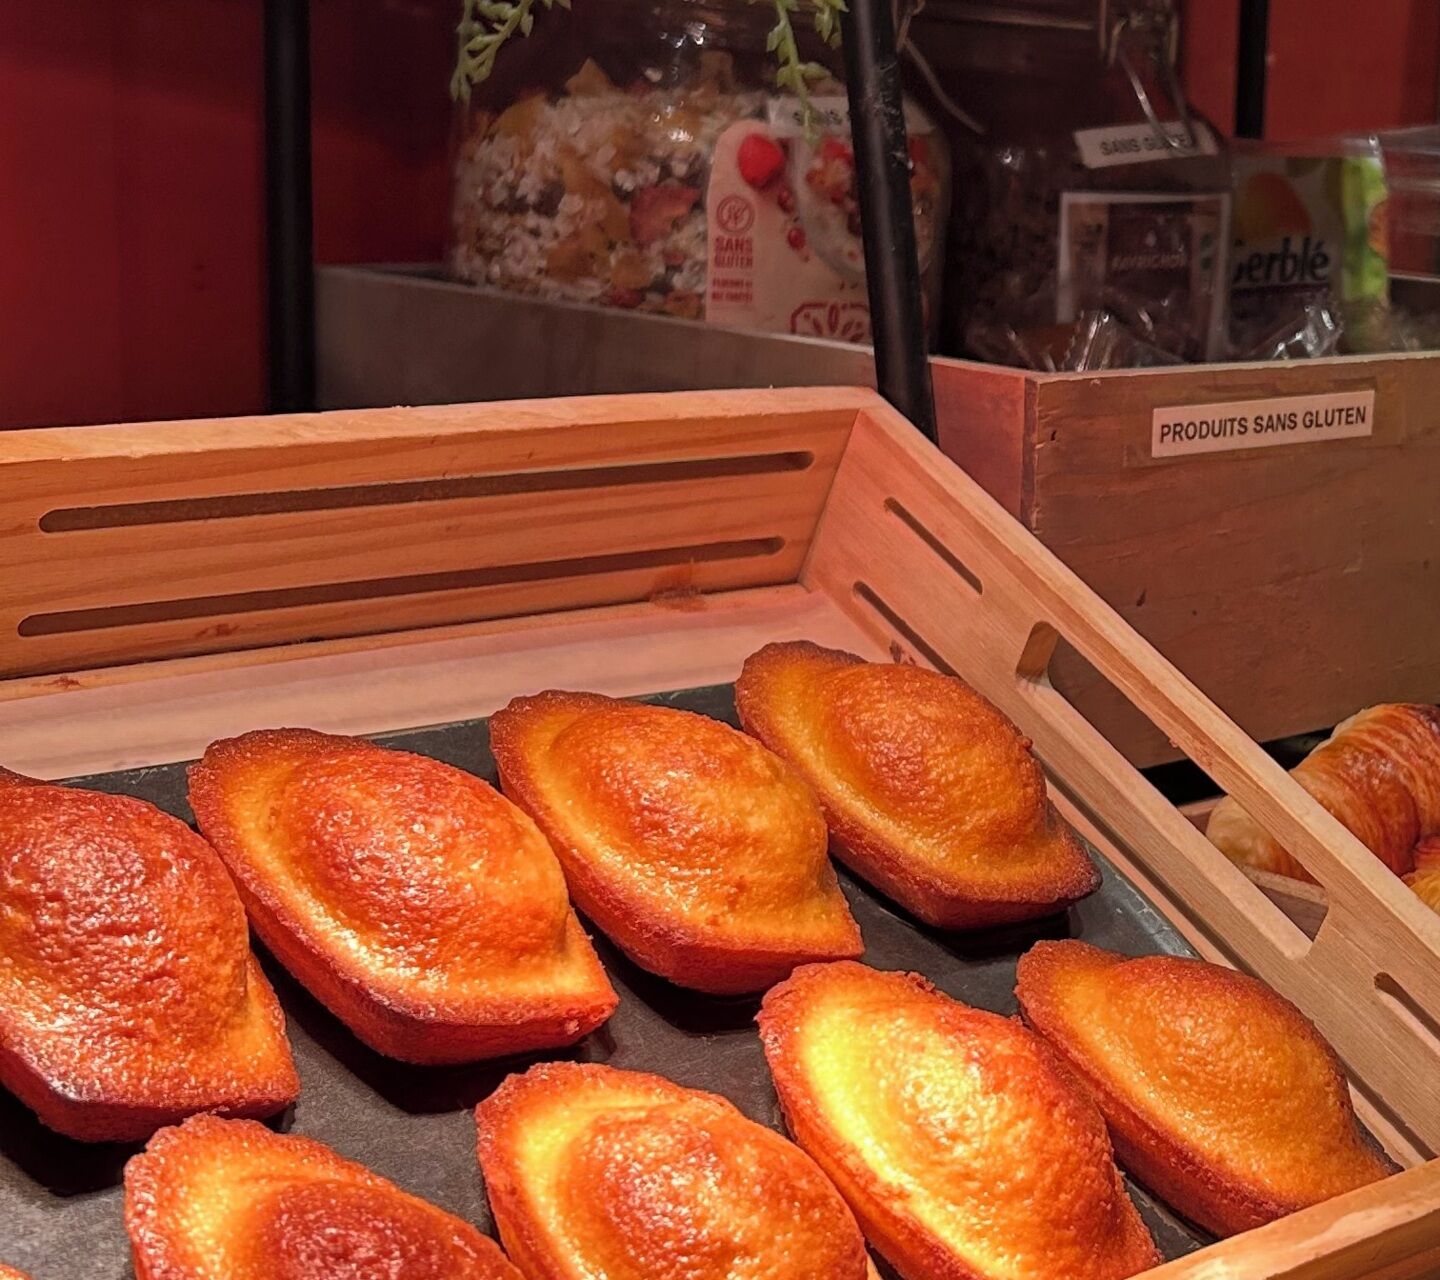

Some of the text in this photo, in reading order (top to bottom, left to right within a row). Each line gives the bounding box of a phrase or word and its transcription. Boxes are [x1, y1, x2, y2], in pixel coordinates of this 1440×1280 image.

[1160, 405, 1367, 444] PRODUITS SANS GLUTEN
